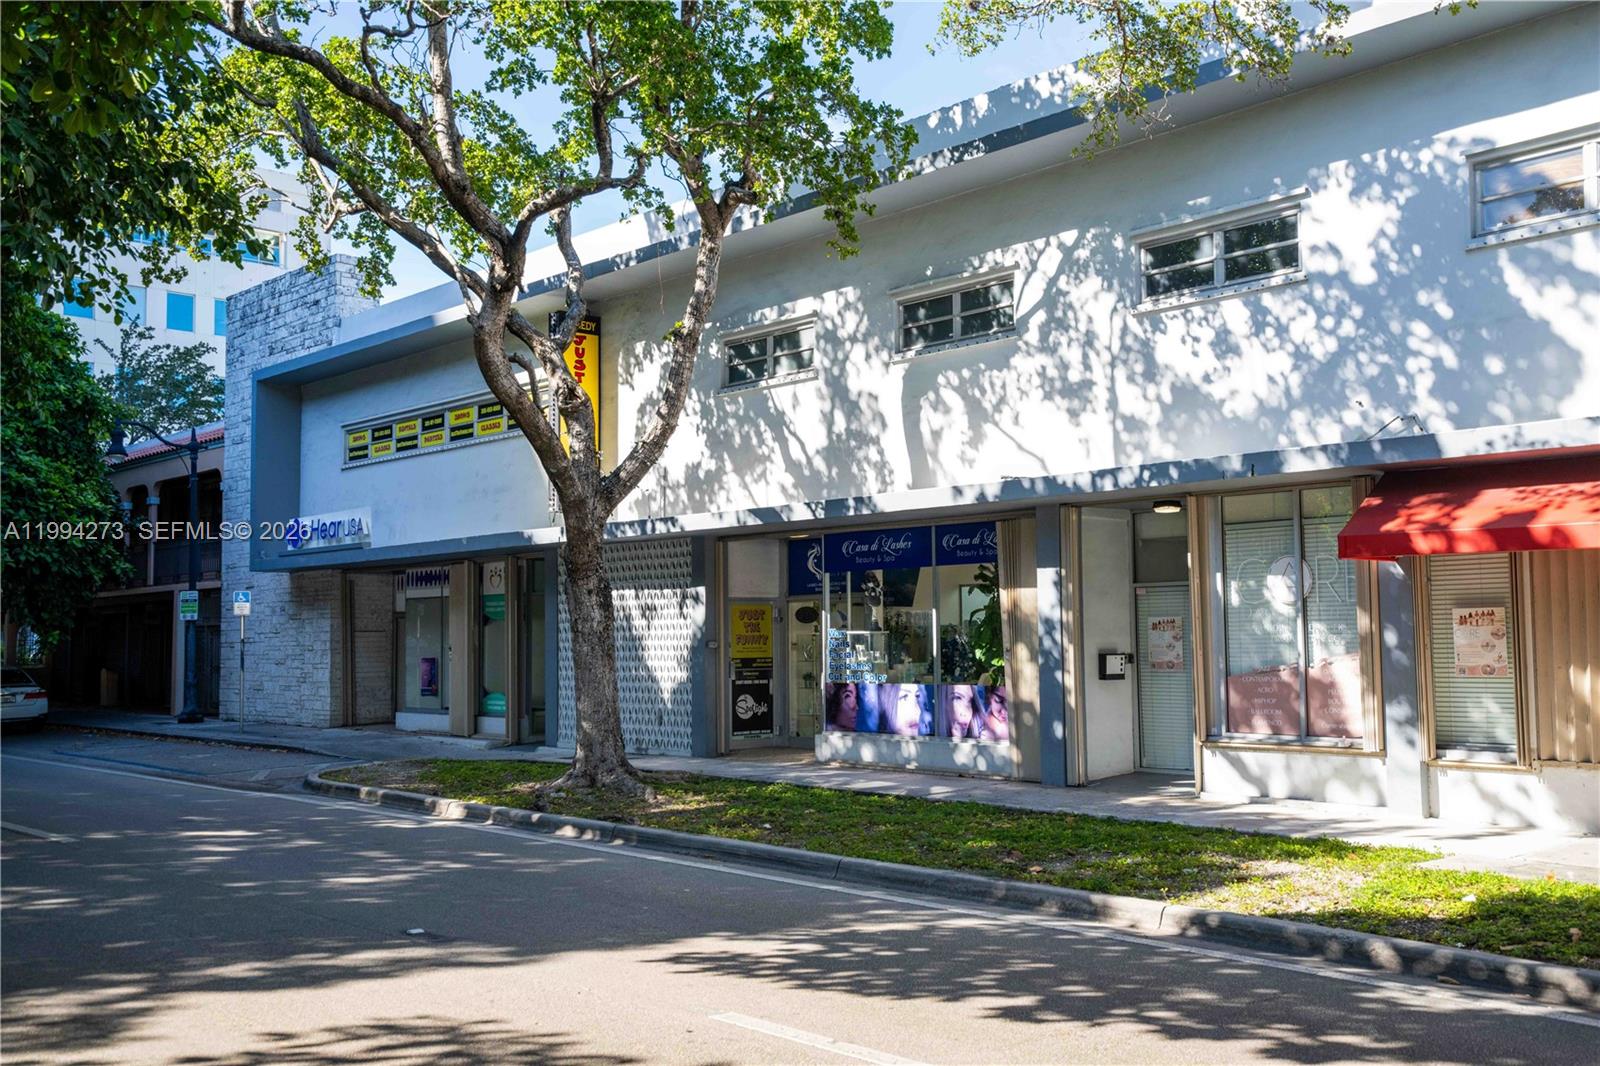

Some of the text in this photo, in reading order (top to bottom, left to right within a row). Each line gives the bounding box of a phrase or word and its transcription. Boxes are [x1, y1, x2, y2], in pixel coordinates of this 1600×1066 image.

[573, 335, 587, 384] JUST
[942, 534, 970, 551] Casa
[842, 541, 869, 557] Casa
[957, 549, 977, 557] Beauty
[829, 640, 850, 649] Nails
[829, 650, 855, 659] Facial
[829, 661, 873, 671] Eyelashes
[828, 671, 888, 683] Cut and Color
